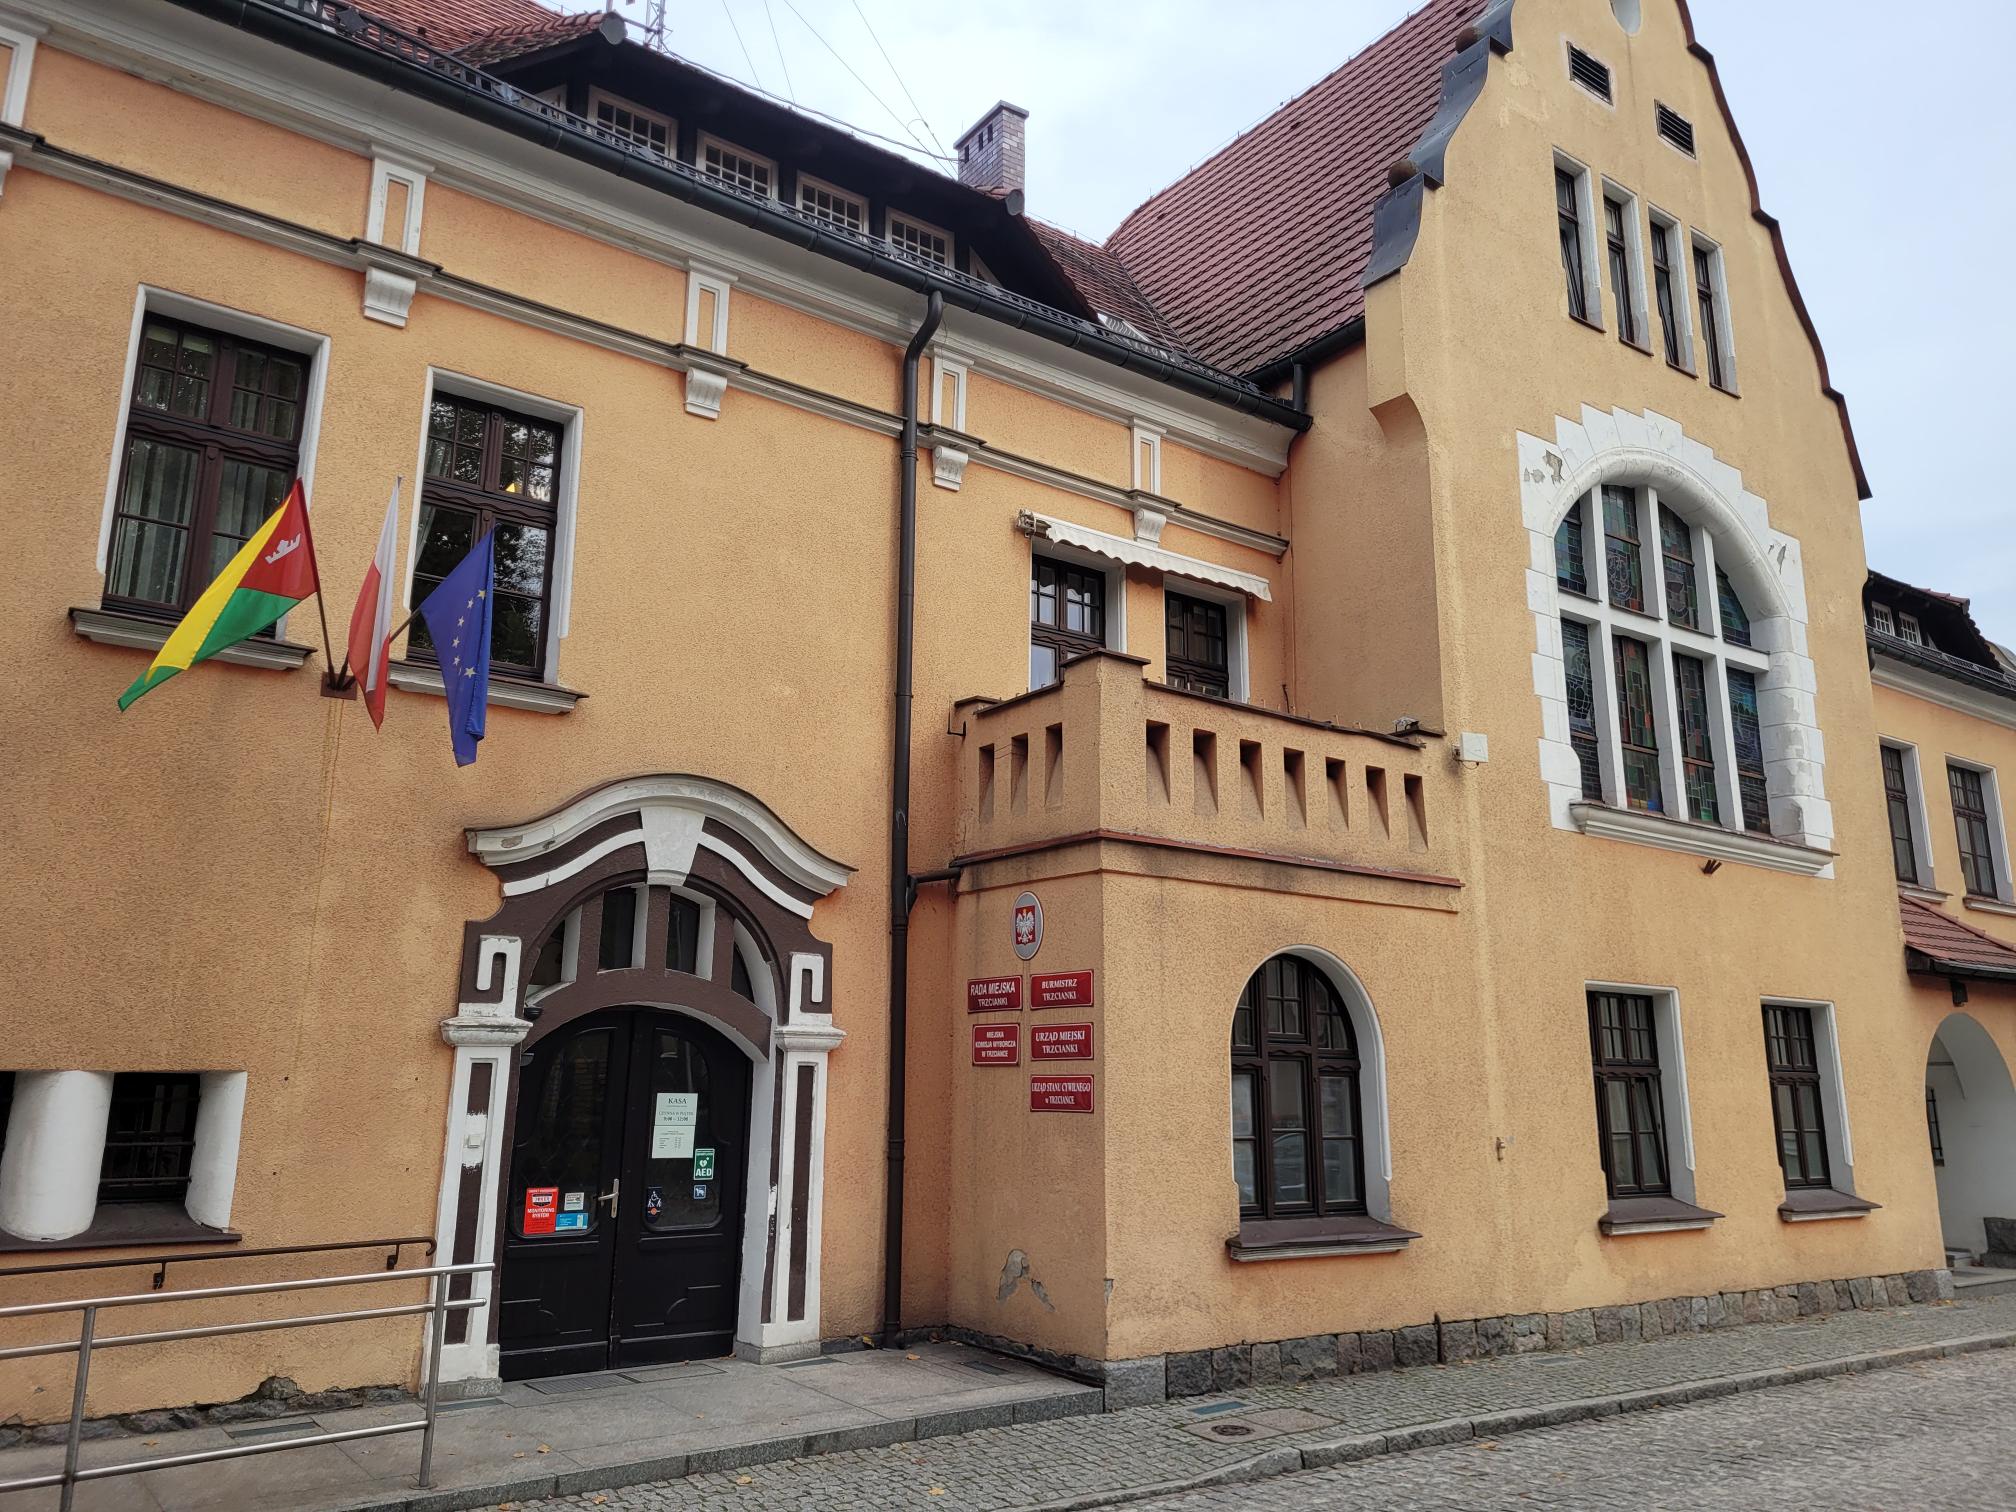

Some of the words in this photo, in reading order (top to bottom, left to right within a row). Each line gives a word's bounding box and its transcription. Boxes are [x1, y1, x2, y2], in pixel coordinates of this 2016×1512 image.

[970, 984, 987, 996] RADA
[988, 981, 1015, 994] MIEJSKA
[1042, 979, 1078, 989] BURMISTRZ
[1042, 991, 1077, 1000] TRZCIANKI
[978, 998, 1008, 1006] TRZCIANKI
[1036, 1032, 1058, 1043] URZĄD
[1060, 1030, 1085, 1041] MIEJSKI
[1042, 1044, 1078, 1054] TRZCIANKI
[696, 1168, 712, 1176] AED
